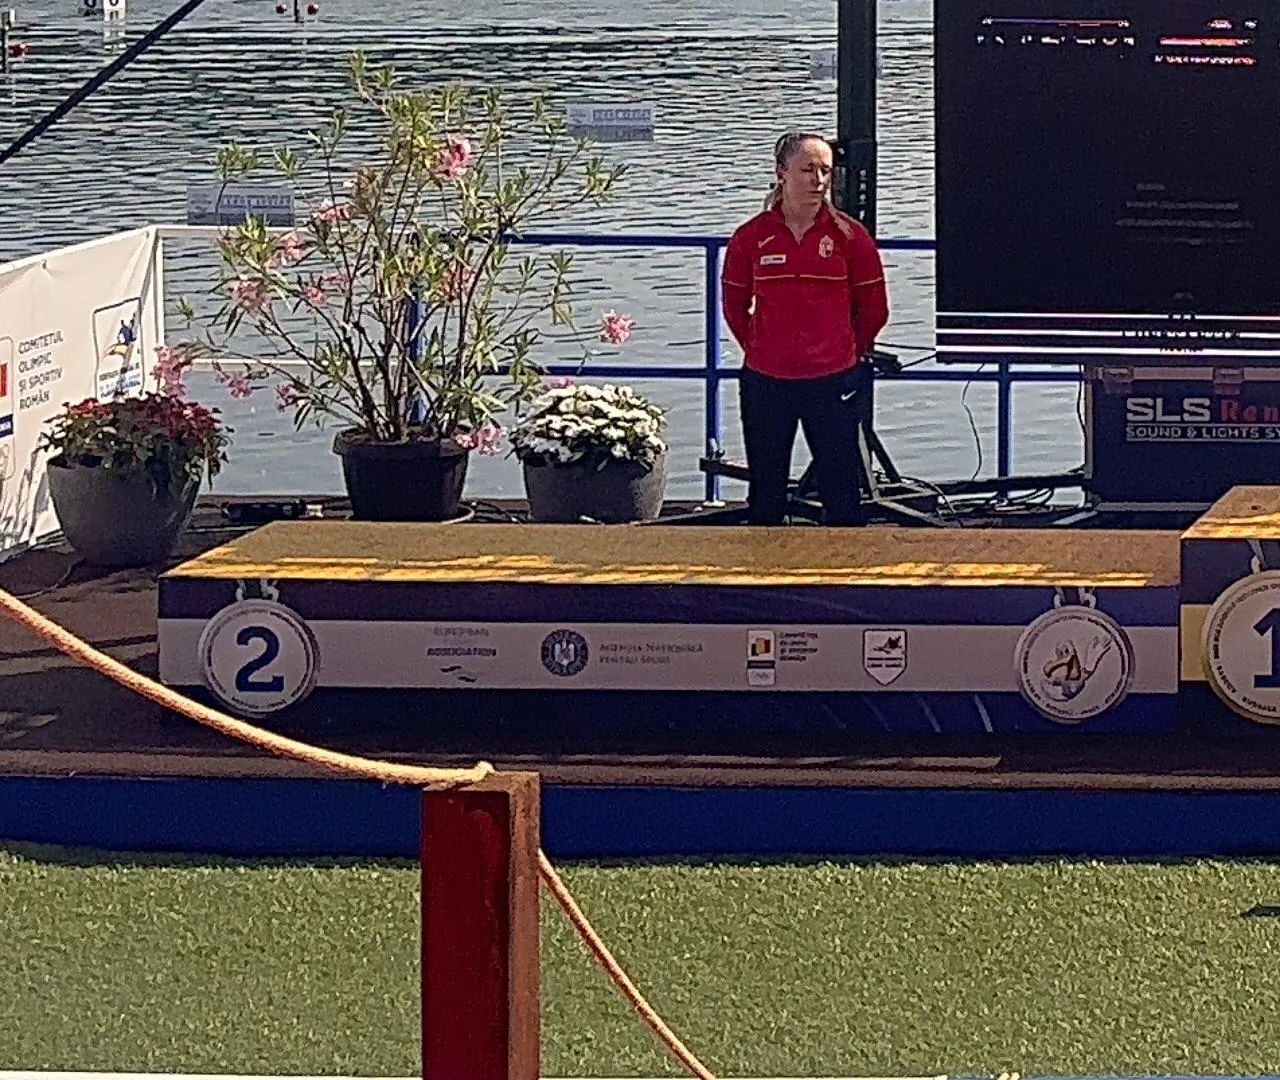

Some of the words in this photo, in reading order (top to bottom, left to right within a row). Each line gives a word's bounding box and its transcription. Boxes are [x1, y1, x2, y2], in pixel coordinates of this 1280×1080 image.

[1126, 397, 1211, 422] SLS
[1126, 425, 1182, 439] SOUND
[1201, 426, 1260, 440] LIGHTS
[234, 625, 286, 693] 2
